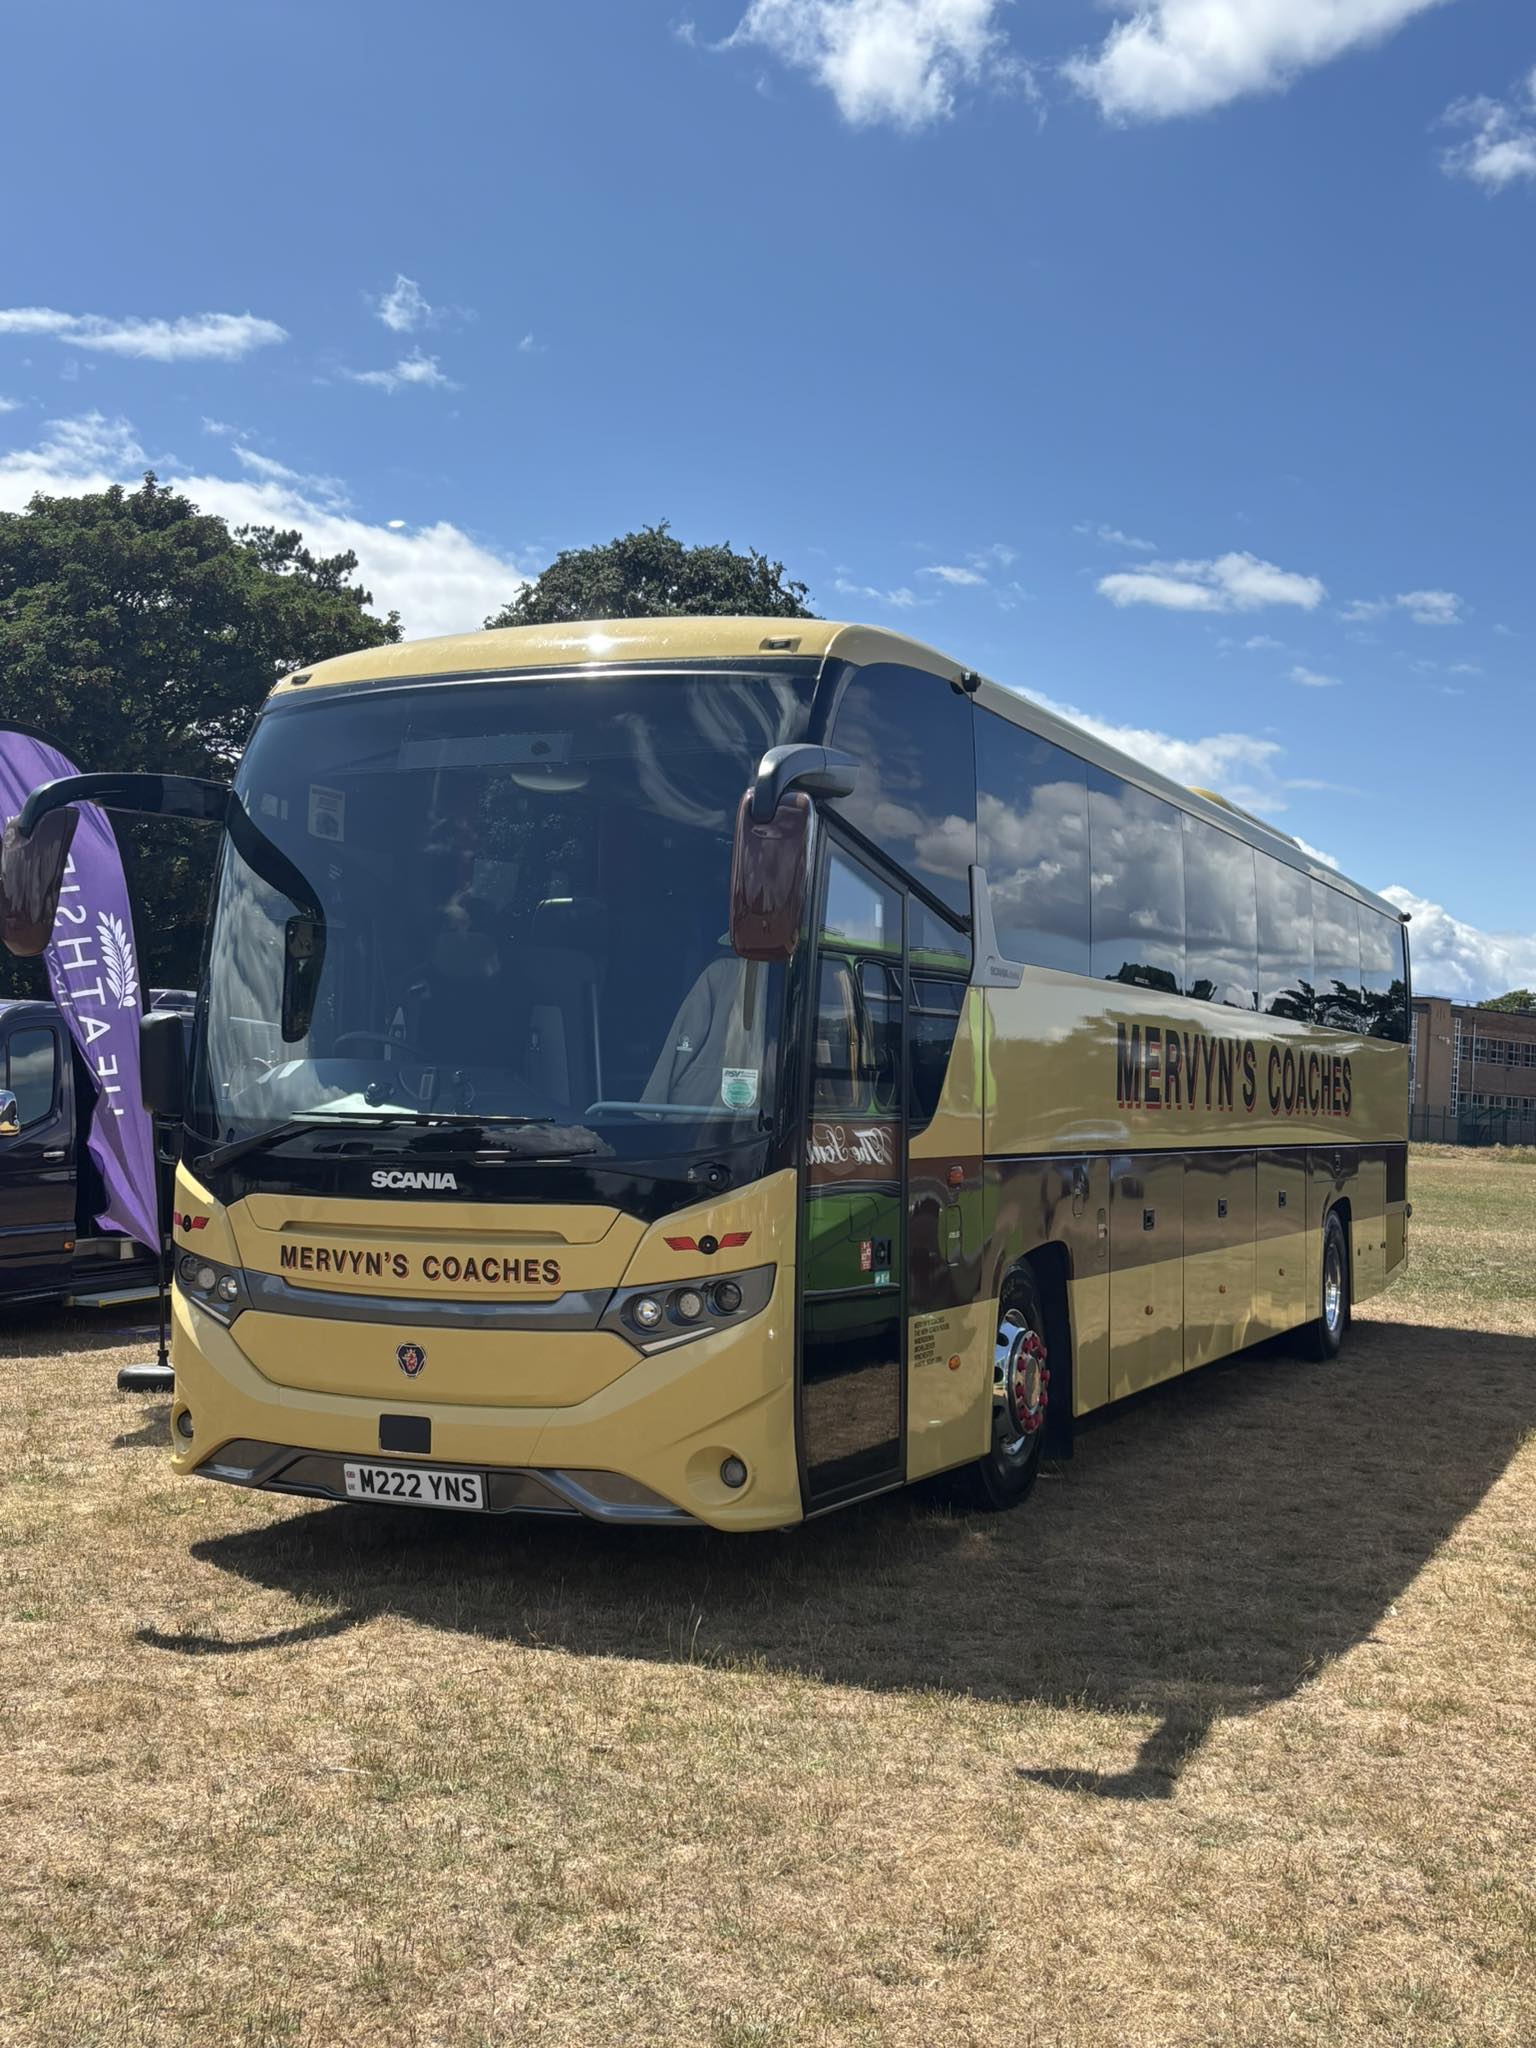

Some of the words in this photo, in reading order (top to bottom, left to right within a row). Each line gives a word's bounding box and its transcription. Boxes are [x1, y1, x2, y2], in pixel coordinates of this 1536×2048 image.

[1116, 1022, 1257, 1113] MERVYN'S
[1268, 1045, 1352, 1117] COACHES
[371, 1171, 457, 1190] SCANIA
[280, 1245, 409, 1278] MERVYN'S
[422, 1255, 561, 1285] COACHES
[359, 1469, 422, 1498] M222
[428, 1475, 477, 1503] YNS
